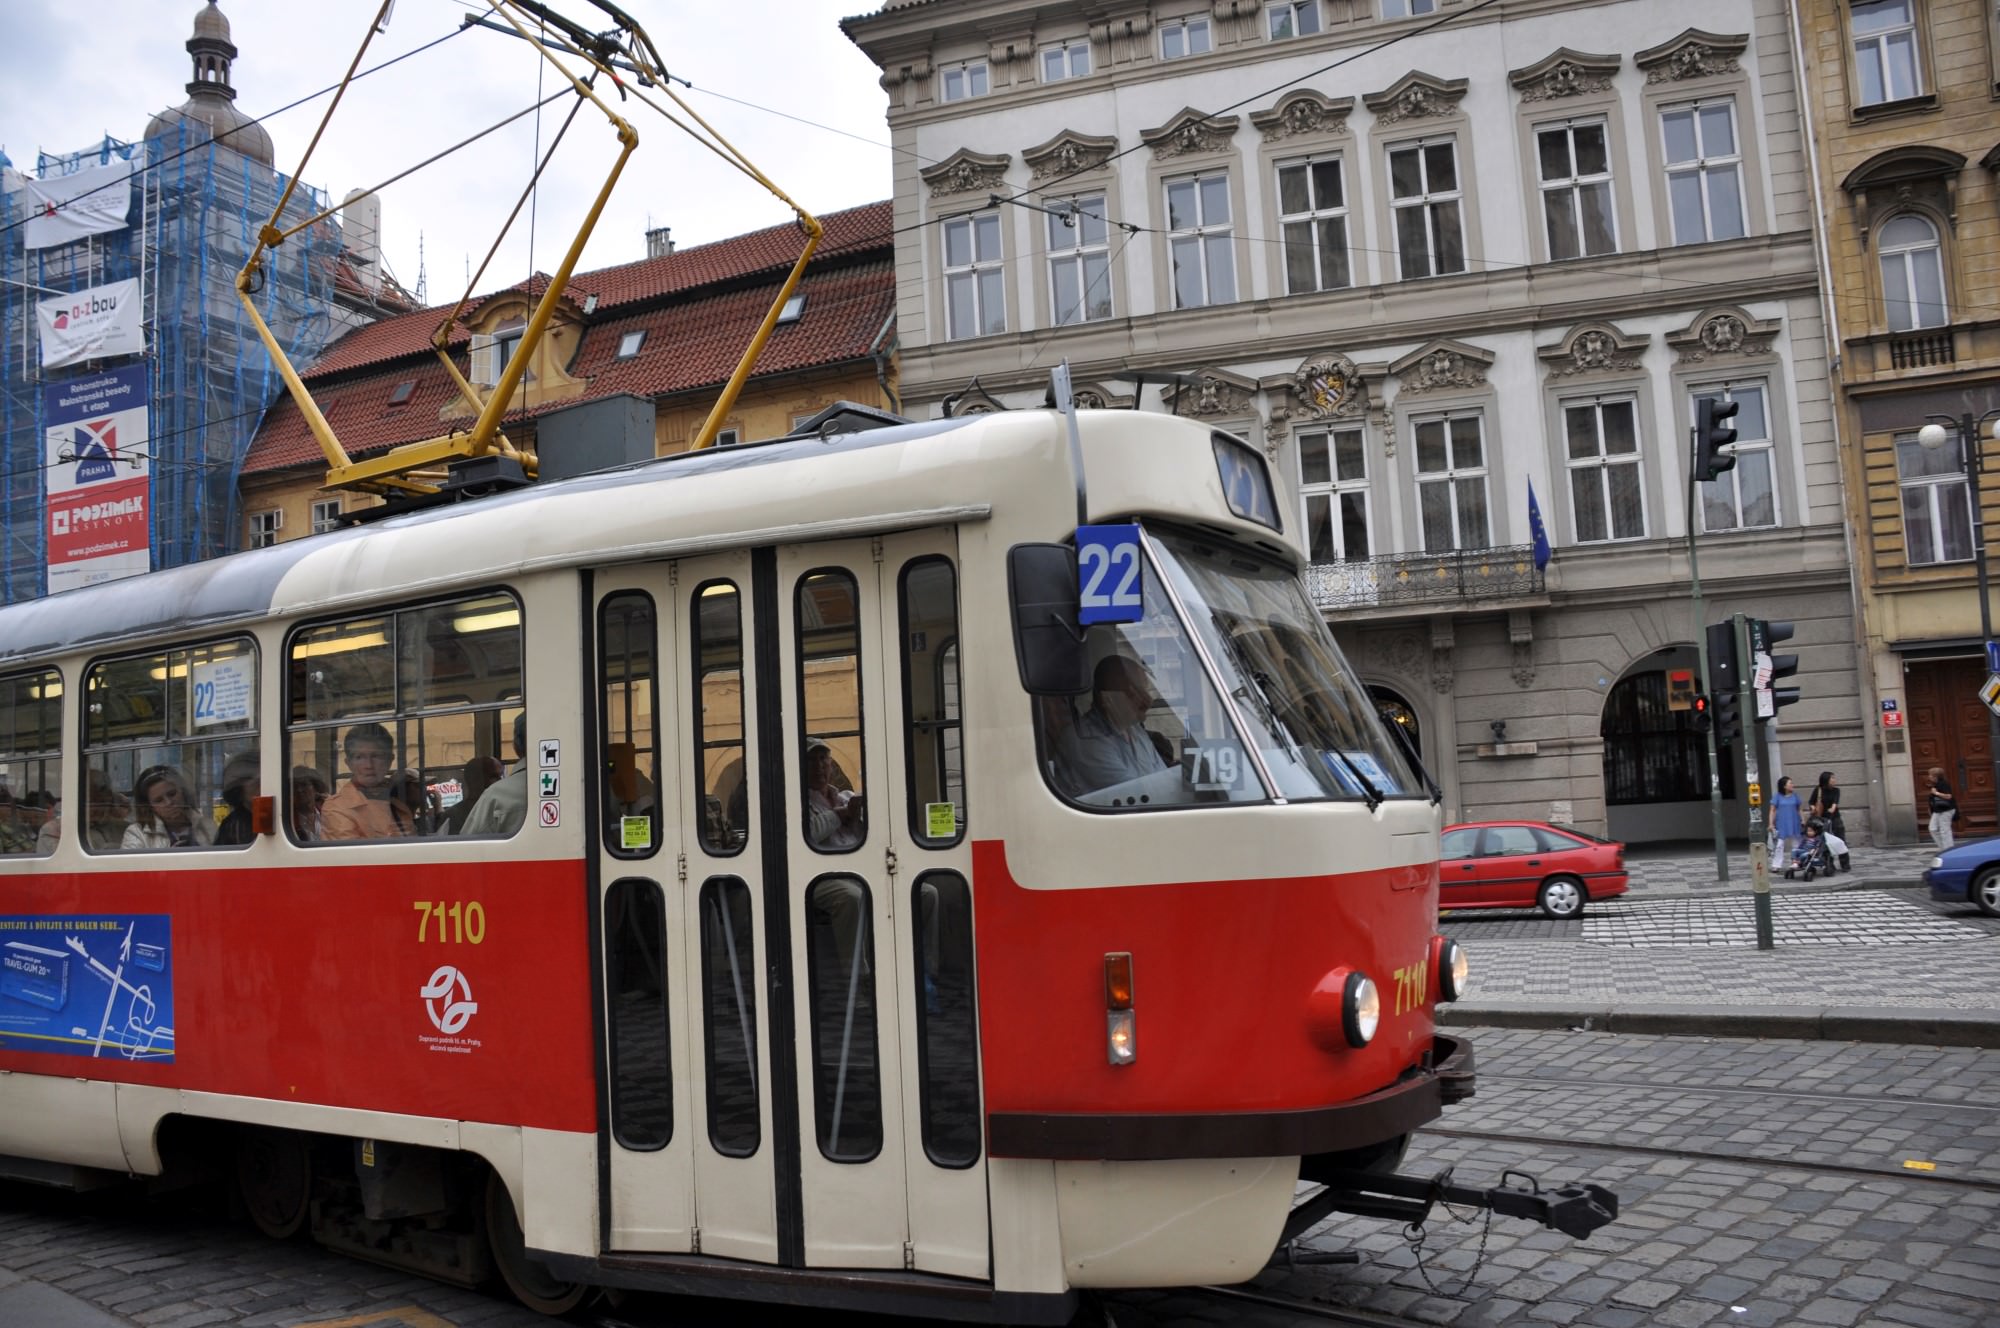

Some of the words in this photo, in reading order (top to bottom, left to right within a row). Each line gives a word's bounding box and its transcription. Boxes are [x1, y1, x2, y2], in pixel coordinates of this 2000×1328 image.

[81, 466, 106, 477] PRAHA
[72, 496, 143, 525] PODZIMEK
[1078, 542, 1141, 608] 22
[195, 680, 215, 718] 22
[1184, 747, 1238, 785] 719
[64, 921, 73, 930] SE
[414, 901, 486, 944] 7110
[4, 957, 38, 973] TRAVEL-GUM
[38, 963, 47, 976] 20
[1393, 960, 1427, 1017] 7110
